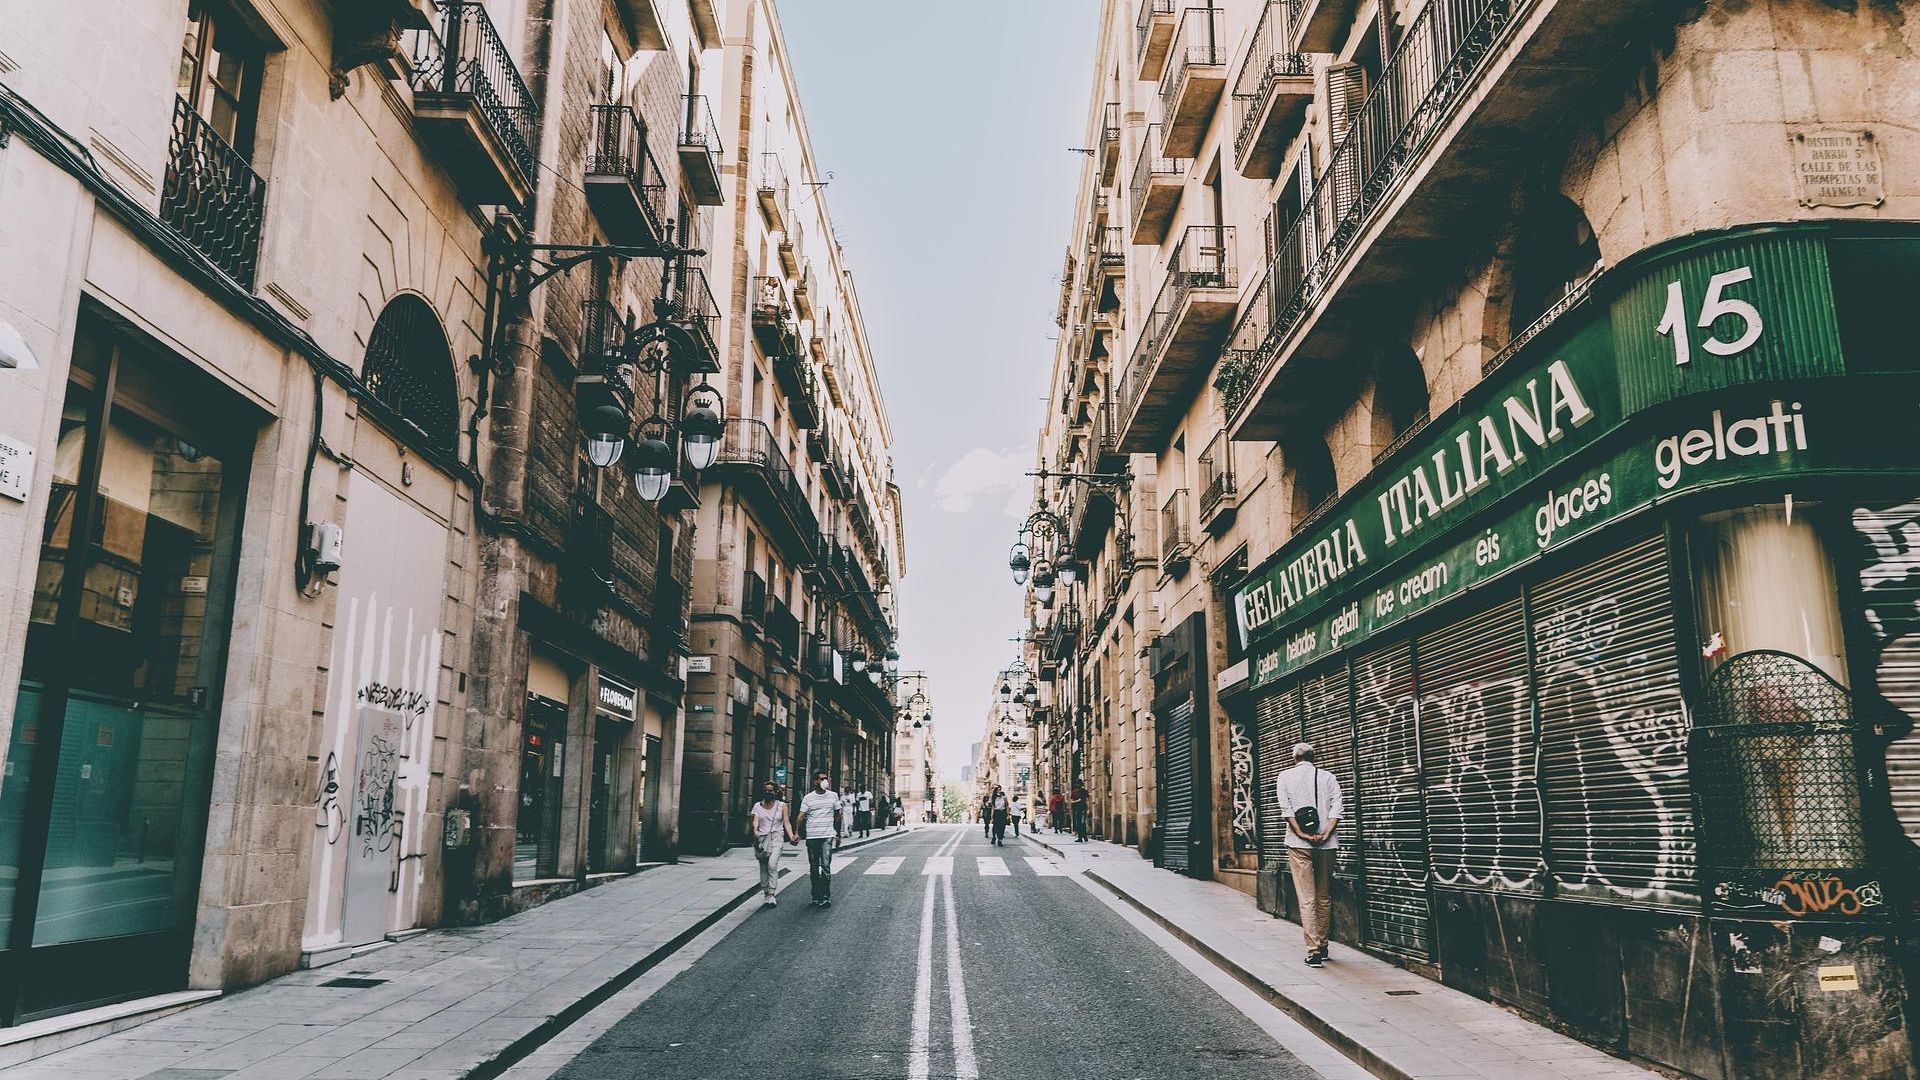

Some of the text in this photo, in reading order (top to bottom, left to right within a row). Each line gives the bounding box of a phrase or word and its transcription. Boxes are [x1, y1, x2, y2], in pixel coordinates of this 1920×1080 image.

[1801, 161, 1877, 173] CALLE DE LAS
[1803, 174, 1879, 185] TROMPETAS DE
[1655, 265, 1764, 366] 15
[1244, 359, 1595, 631] GELATERIA ITALIANA
[1286, 628, 1316, 661] helados
[1331, 601, 1359, 648] gelati
[1375, 589, 1395, 618] ice
[1400, 561, 1449, 606] cream
[1475, 528, 1500, 567] eis
[1535, 472, 1612, 548] glaces
[1655, 401, 1808, 489] gelati
